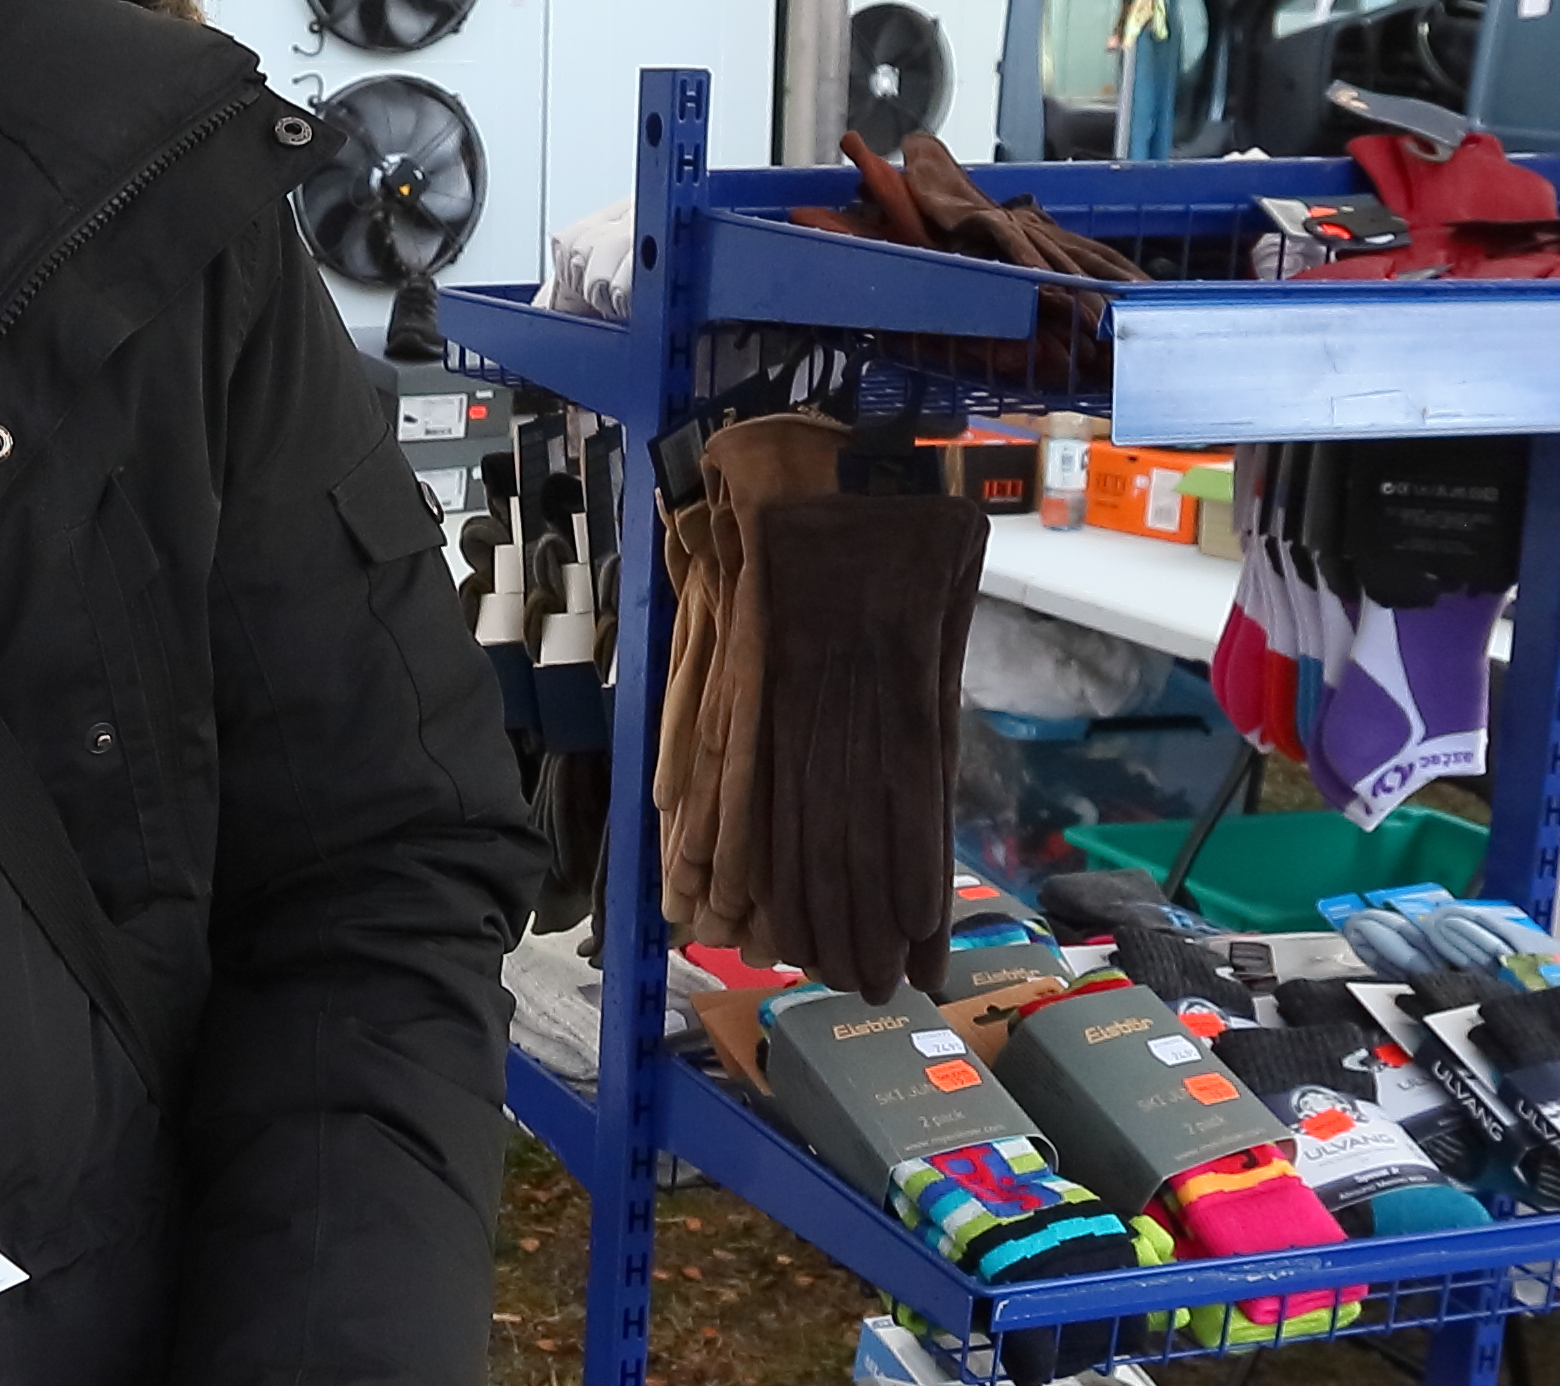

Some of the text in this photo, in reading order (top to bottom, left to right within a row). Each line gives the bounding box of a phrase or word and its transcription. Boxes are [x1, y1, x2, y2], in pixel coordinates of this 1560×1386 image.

[832, 1015, 910, 1041] Eisbär
[1084, 1016, 1154, 1045] Eisbär
[1434, 1060, 1506, 1143] ULVANG
[1303, 1132, 1397, 1161] ULVANG
